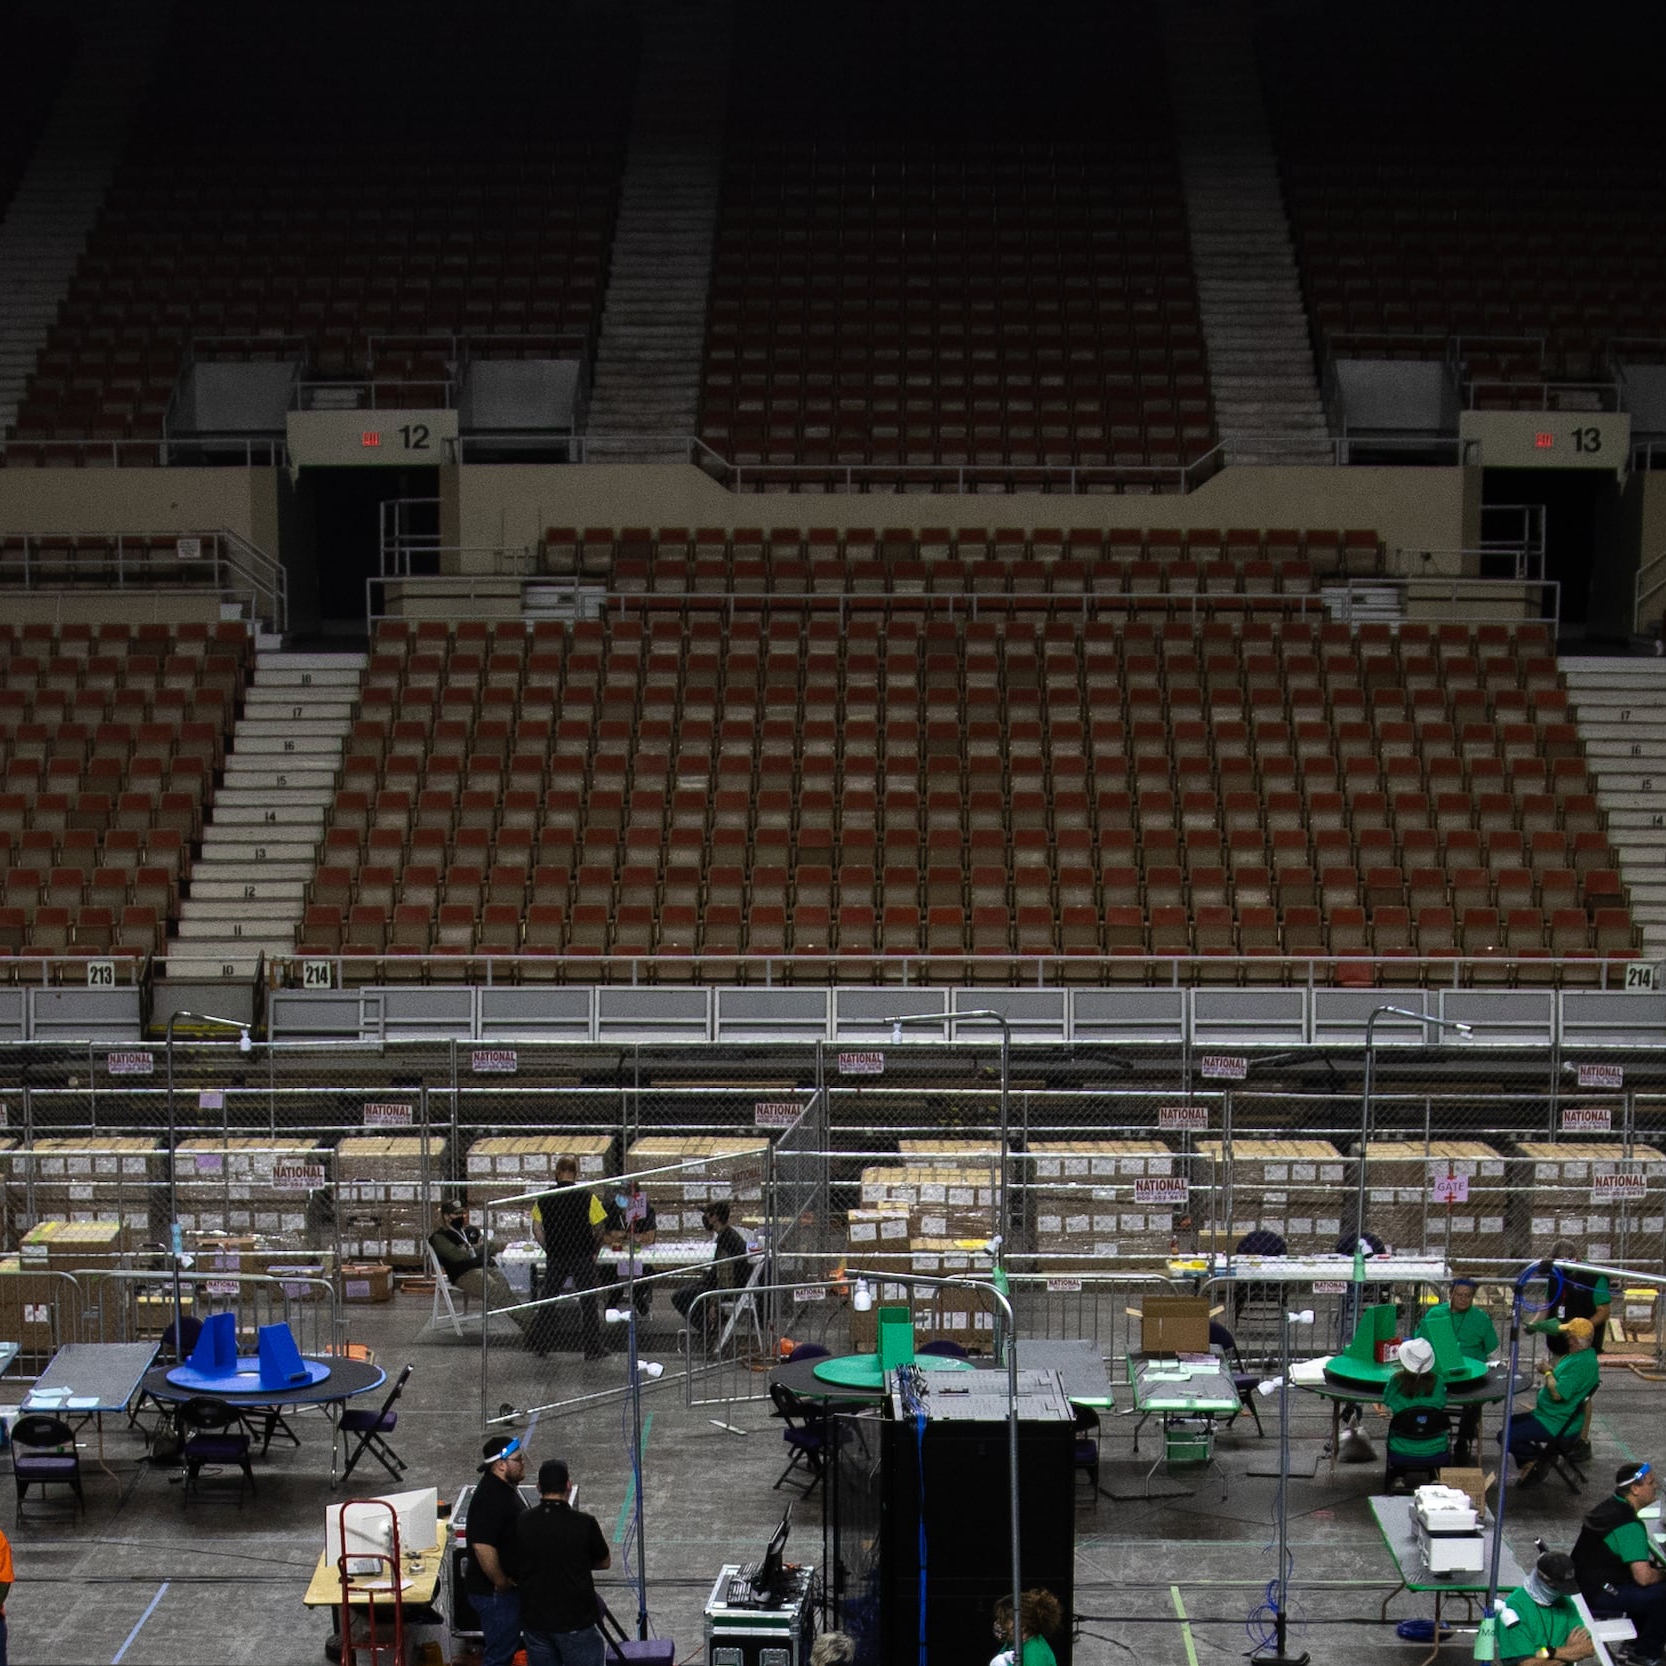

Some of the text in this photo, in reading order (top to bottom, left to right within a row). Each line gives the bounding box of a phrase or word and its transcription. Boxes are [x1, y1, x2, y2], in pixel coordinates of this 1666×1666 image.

[399, 425, 430, 450] 12
[1571, 427, 1602, 453] 13
[90, 966, 113, 985] 213
[306, 966, 329, 984] 214
[1629, 968, 1651, 987] 214
[110, 1053, 150, 1063] NATIONAL
[474, 1052, 514, 1062] NATIONAL
[840, 1053, 881, 1064] NATIONAL
[1204, 1057, 1245, 1069] NATIONAL
[1580, 1066, 1621, 1077] NATIONAL
[365, 1104, 411, 1116] NATIONAL
[757, 1104, 802, 1116] NATIONAL
[1161, 1109, 1207, 1120] NATIONAL
[1564, 1111, 1610, 1121] NATIONAL
[273, 1166, 323, 1178] NATIONAL
[1136, 1180, 1187, 1191] NATIONAL
[1437, 1182, 1465, 1191] GATE
[1595, 1176, 1646, 1187] NATIONAL
[1049, 1279, 1080, 1287] NATIONAL
[796, 1288, 825, 1297] NATIONAL
